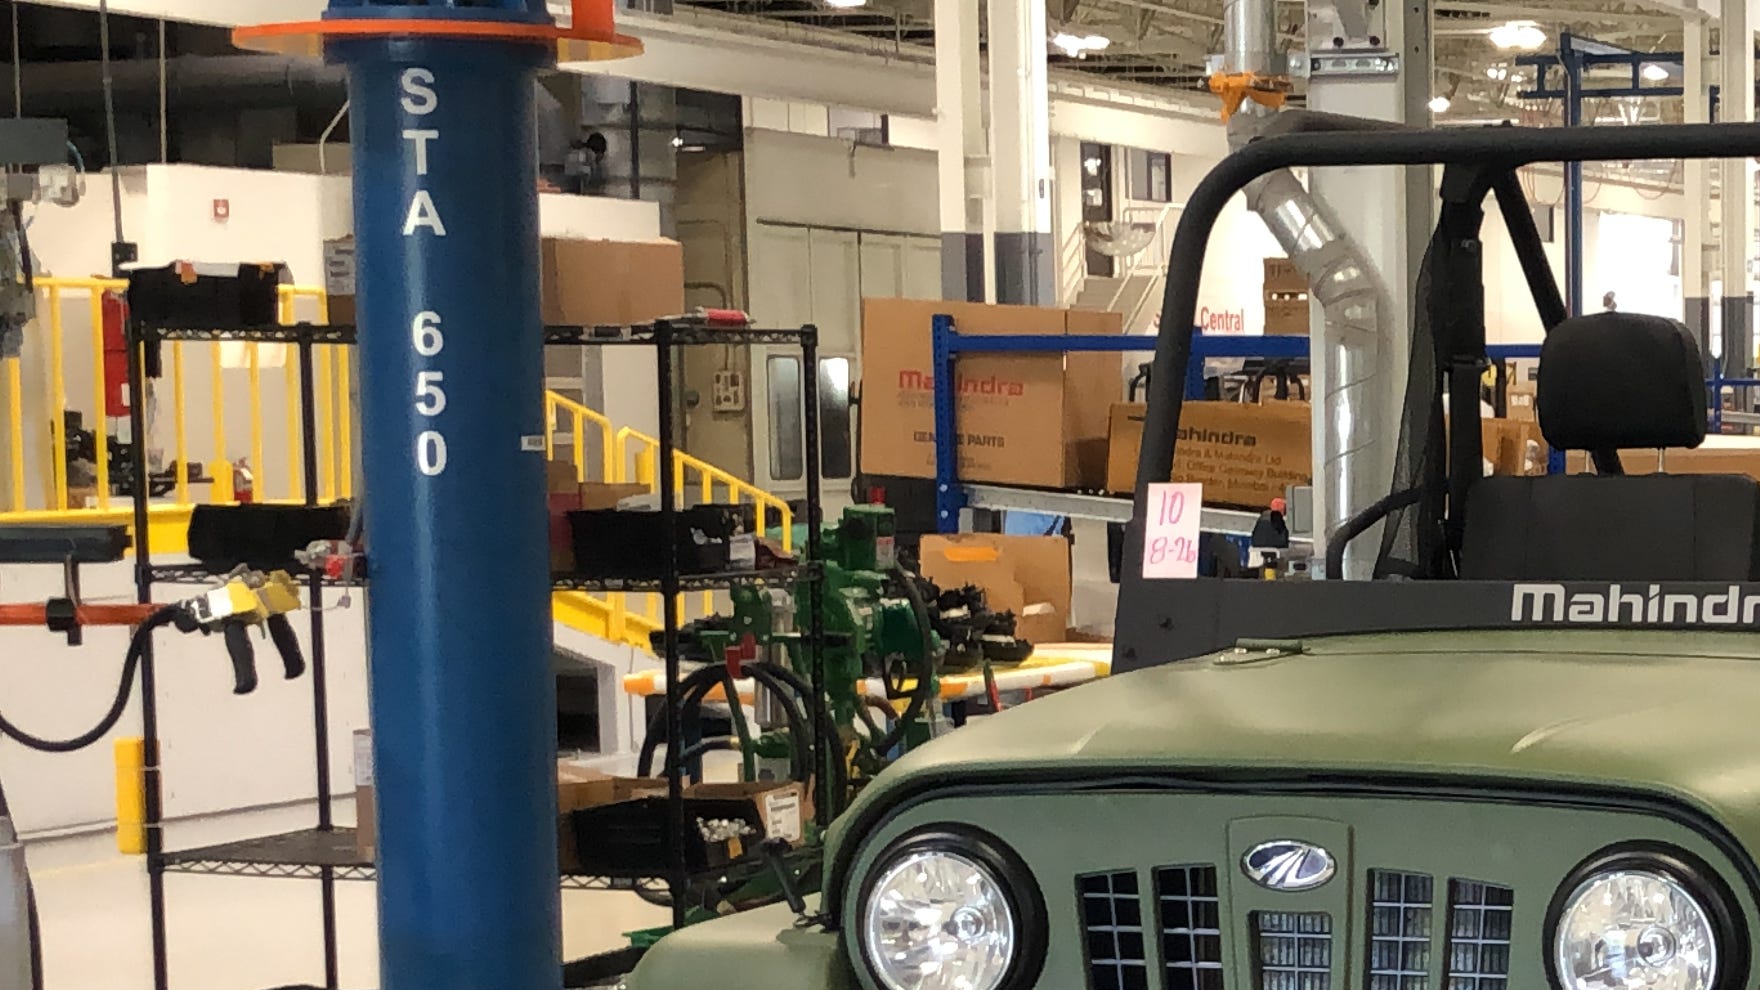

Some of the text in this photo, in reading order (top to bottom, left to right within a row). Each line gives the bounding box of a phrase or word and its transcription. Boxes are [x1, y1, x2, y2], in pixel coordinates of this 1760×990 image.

[400, 67, 448, 476] STA 650
[1200, 306, 1245, 331] Central
[899, 369, 1025, 396] Maindra
[967, 433, 1005, 448] PARTS
[1176, 426, 1257, 447] ahindra
[1159, 489, 1185, 527] 10
